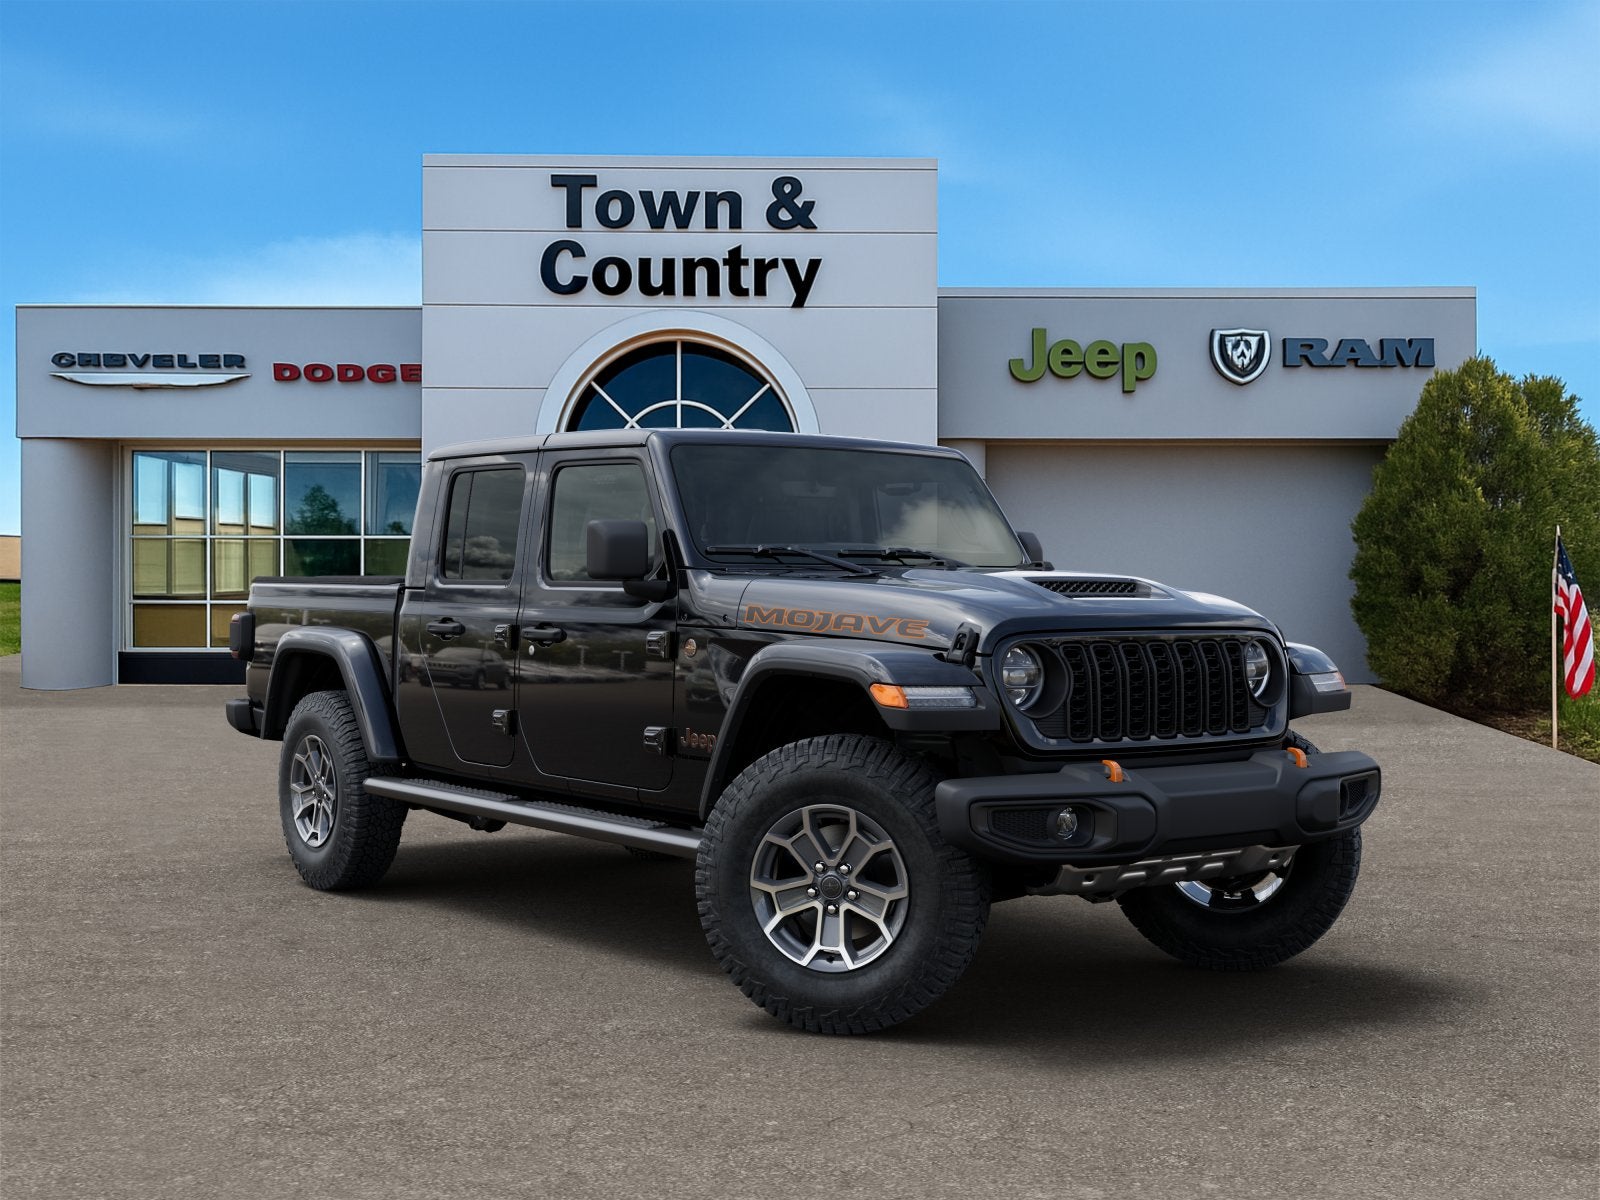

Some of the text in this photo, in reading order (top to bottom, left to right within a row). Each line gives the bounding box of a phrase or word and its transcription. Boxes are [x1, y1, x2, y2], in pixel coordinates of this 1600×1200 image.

[550, 173, 818, 230] Town &
[539, 239, 822, 309] Country
[1008, 327, 1157, 393] Jeep
[1283, 337, 1435, 368] RAM
[273, 363, 422, 383] DODGE
[745, 605, 929, 638] MOJAVE
[680, 728, 716, 752] Jeep
